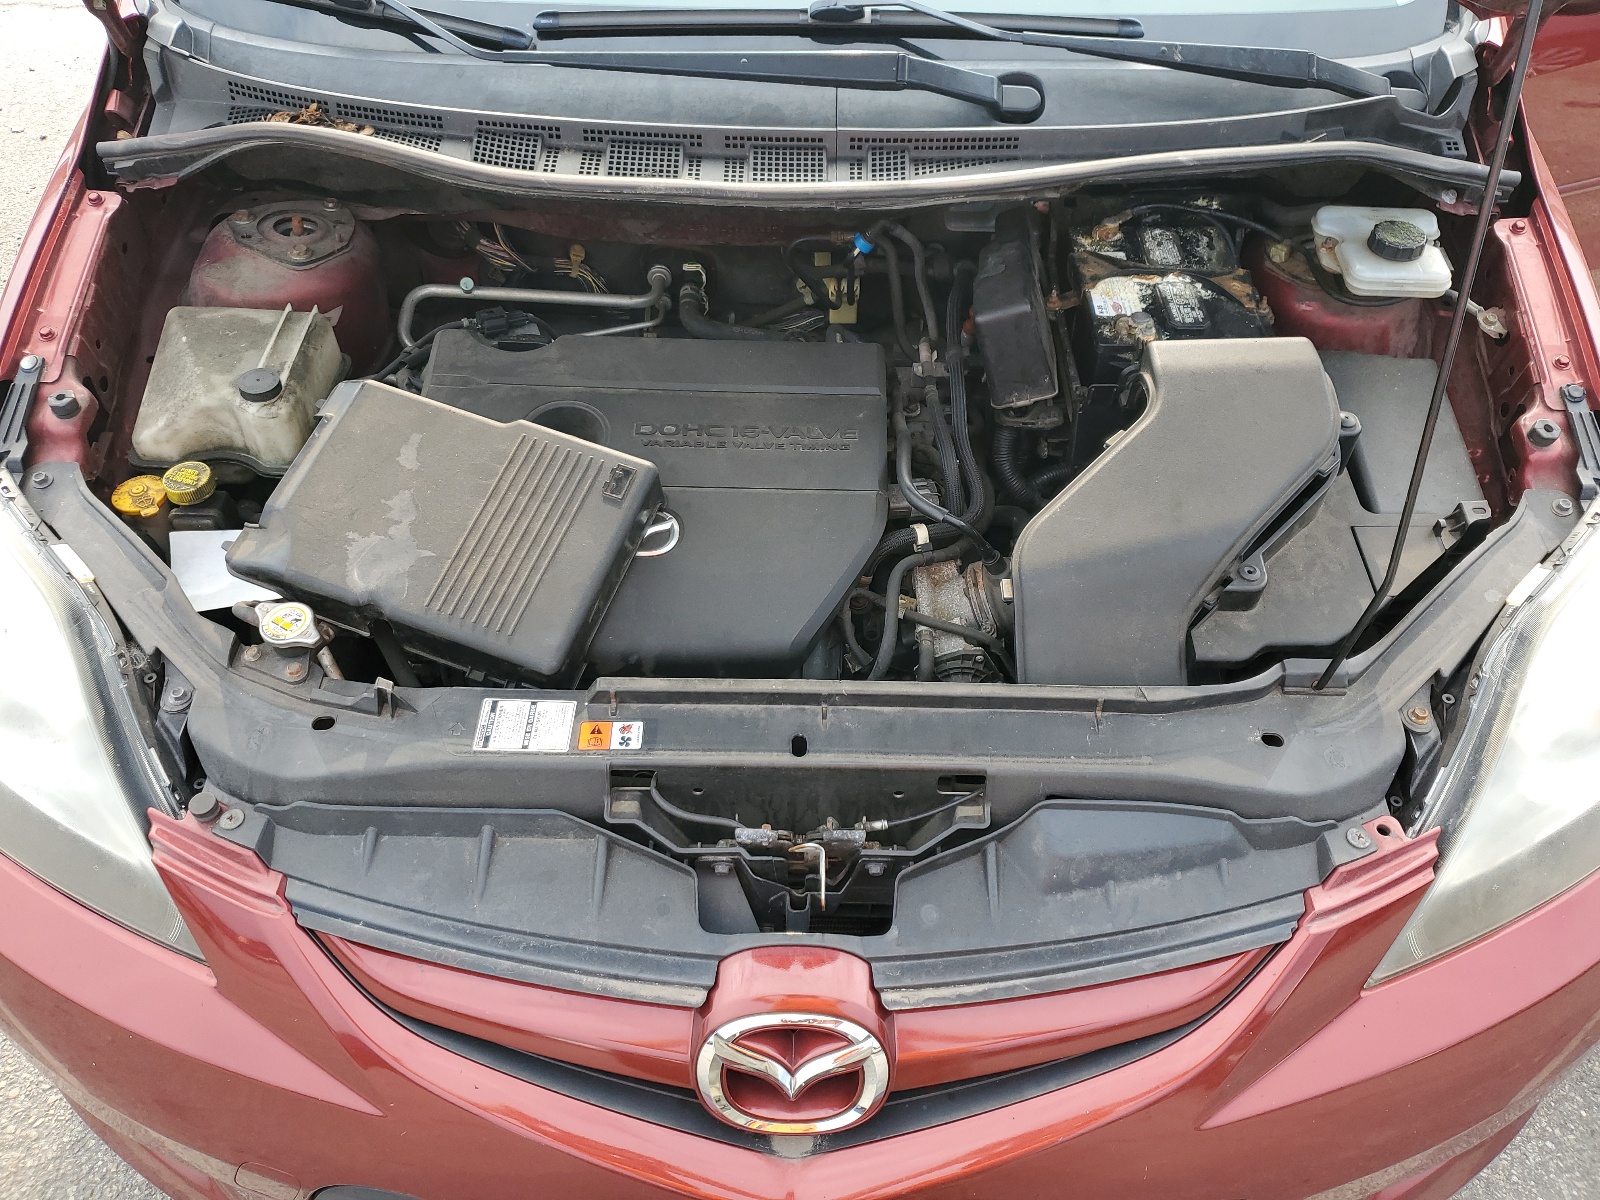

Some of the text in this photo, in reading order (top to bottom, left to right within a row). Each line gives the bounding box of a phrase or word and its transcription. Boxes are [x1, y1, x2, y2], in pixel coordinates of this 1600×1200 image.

[634, 422, 859, 441] DOHC 16-VALVE
[640, 438, 852, 452] VARIABLE VALVE TIMING
[485, 712, 496, 736] CAUTION
